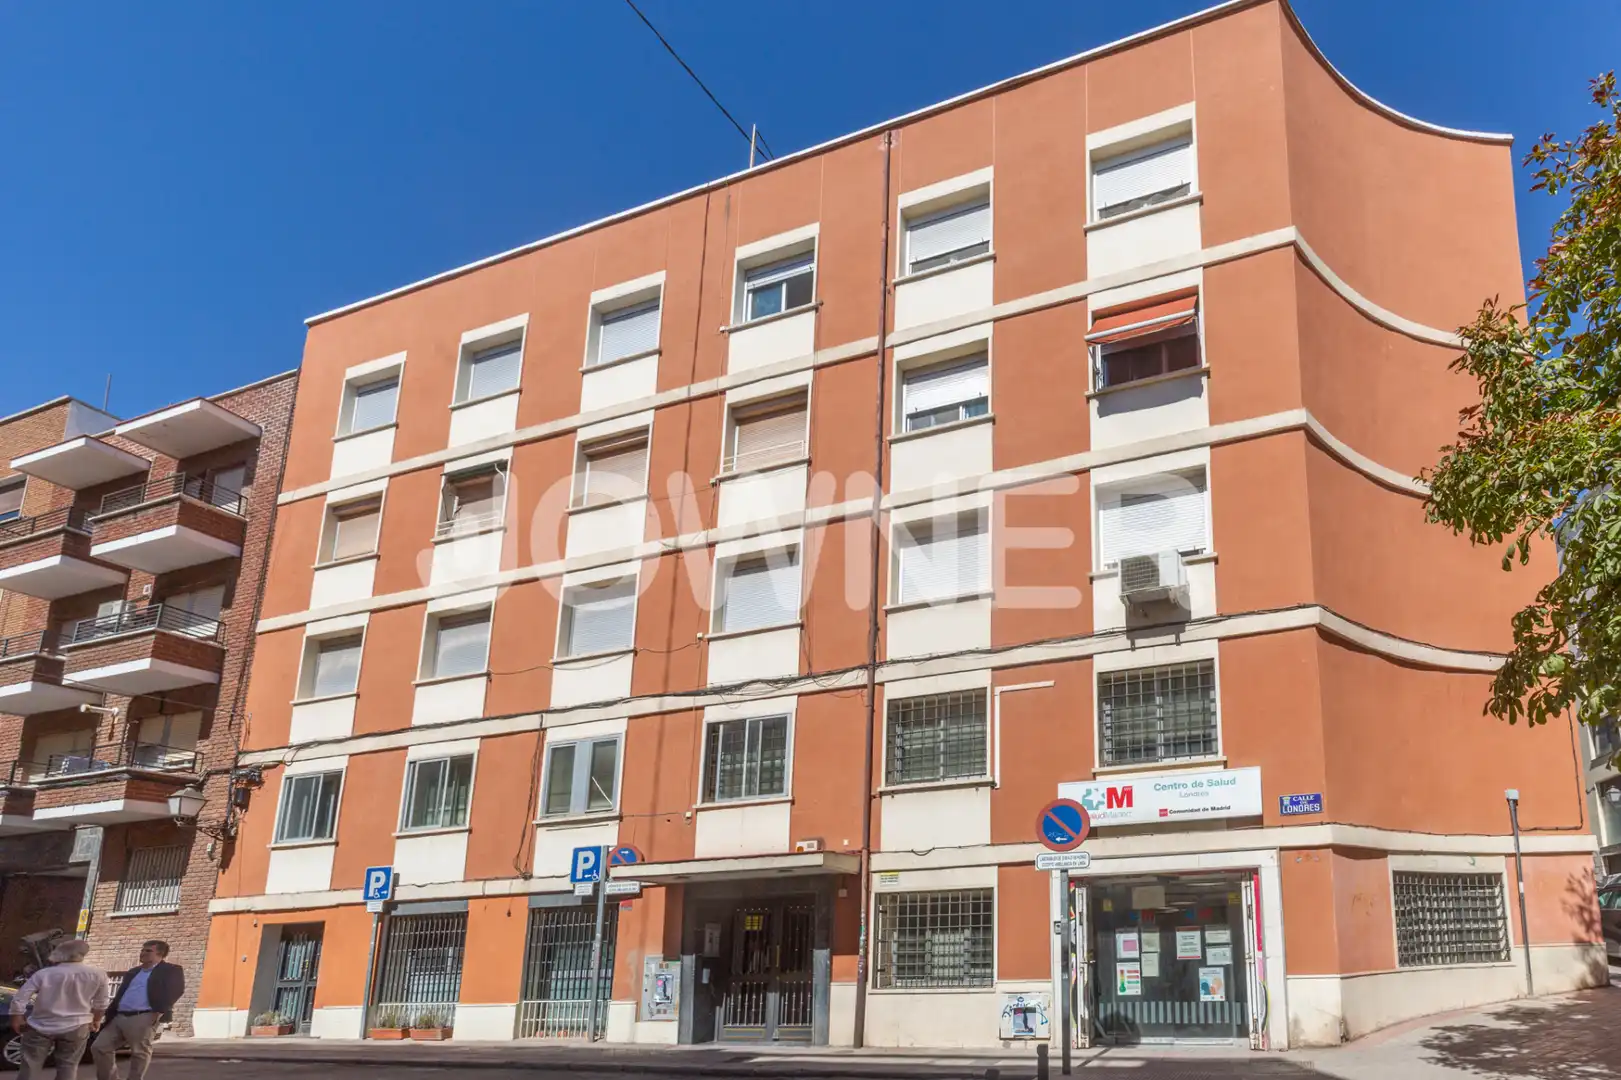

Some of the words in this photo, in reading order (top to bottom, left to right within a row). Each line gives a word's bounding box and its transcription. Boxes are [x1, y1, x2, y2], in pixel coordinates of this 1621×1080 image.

[1154, 782, 1188, 791] Centro
[1192, 780, 1204, 788] de
[1207, 777, 1236, 787] Salud
[1106, 785, 1133, 809] M
[1282, 803, 1320, 813] LONDRES
[576, 850, 595, 879] P
[368, 871, 386, 897] P
